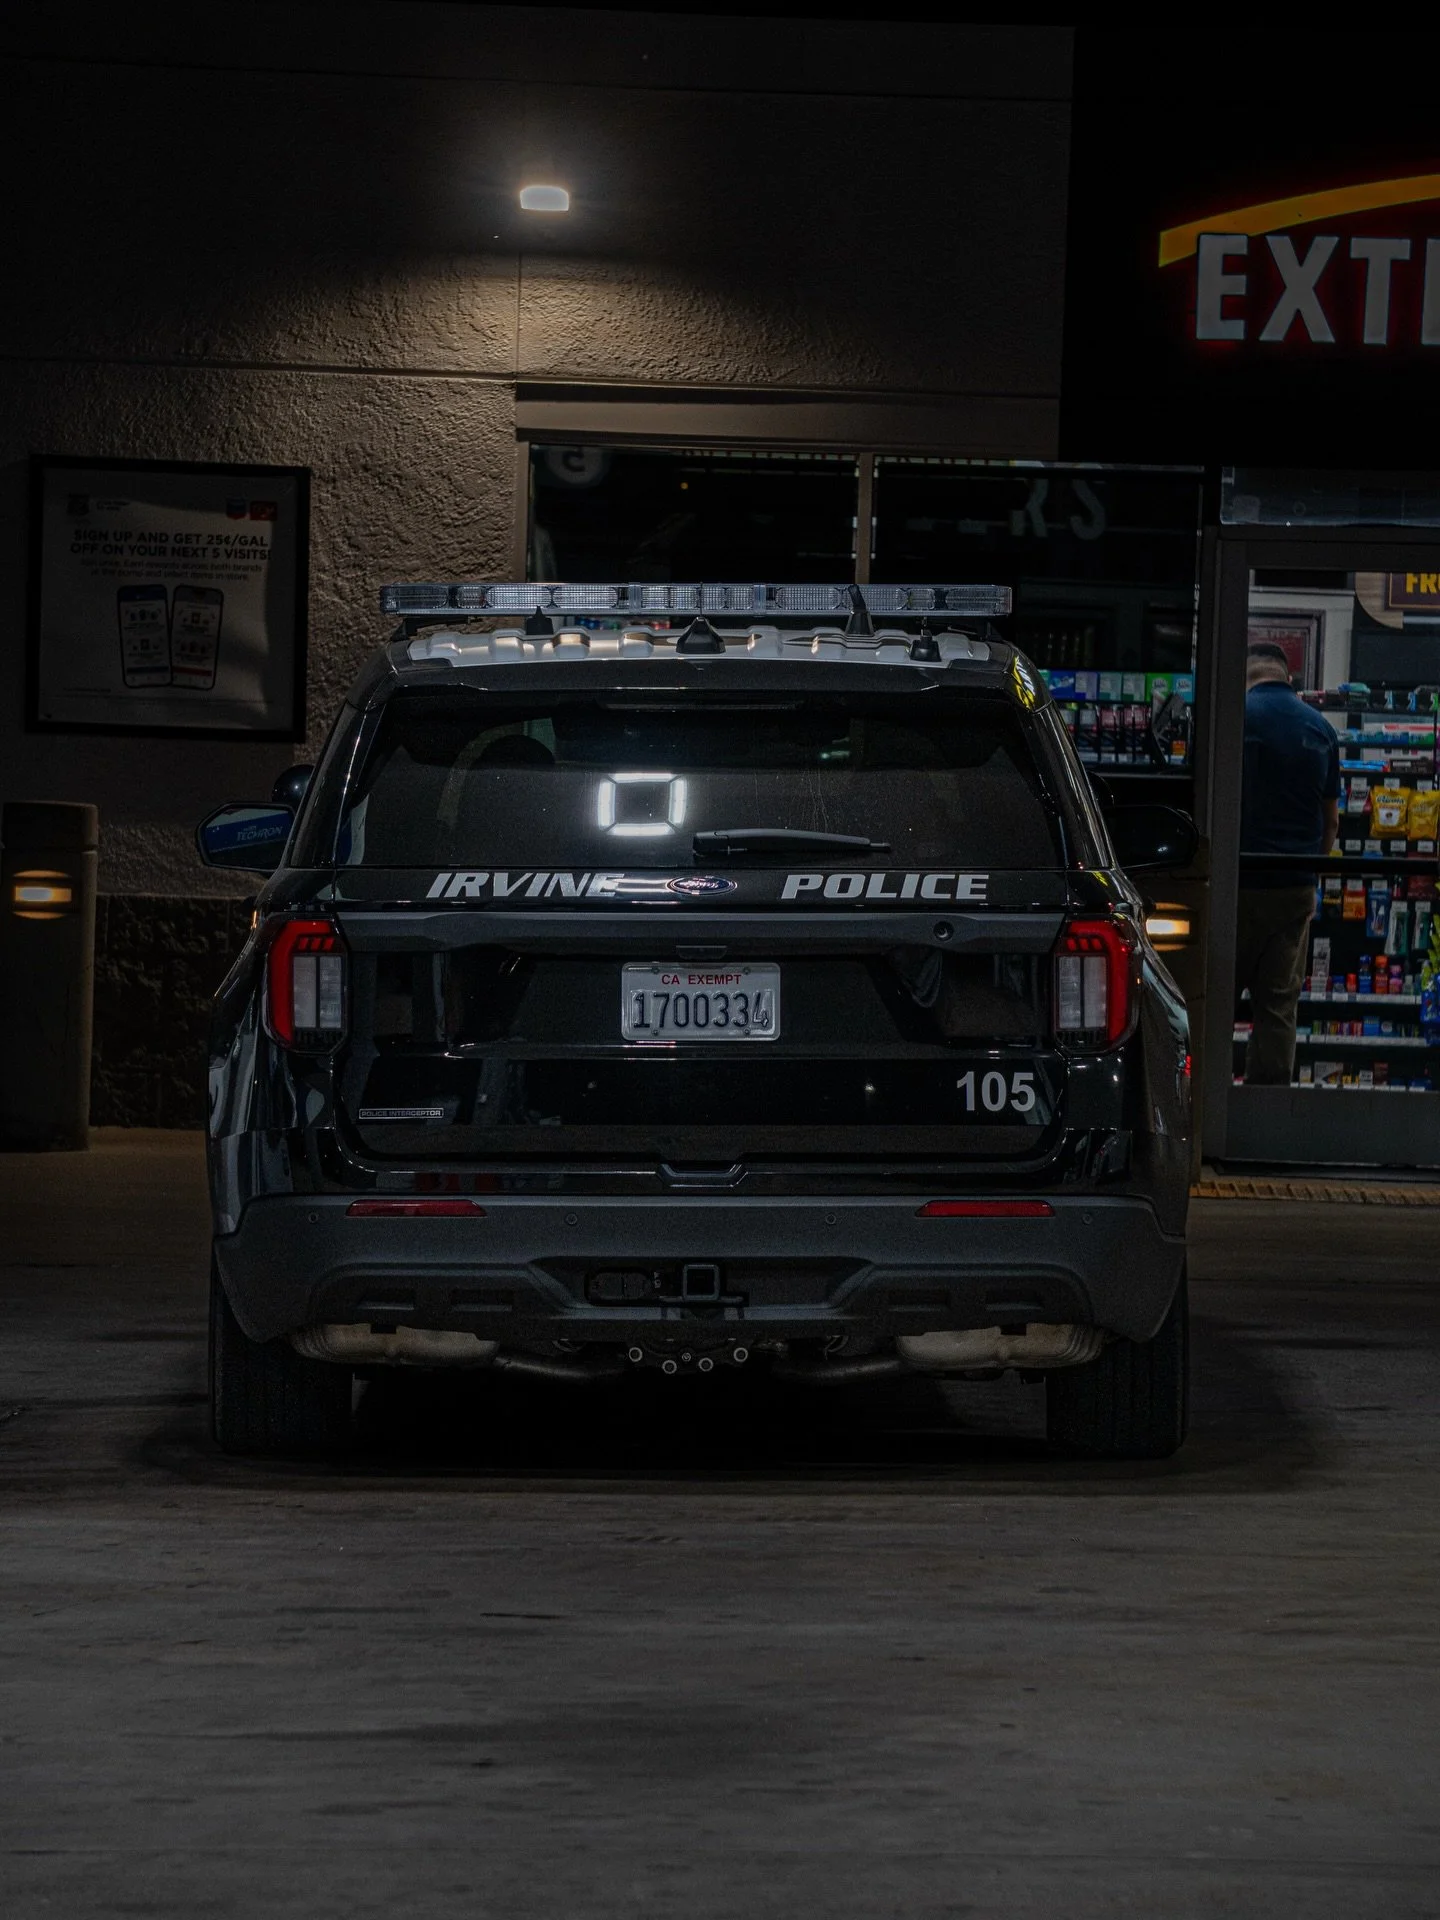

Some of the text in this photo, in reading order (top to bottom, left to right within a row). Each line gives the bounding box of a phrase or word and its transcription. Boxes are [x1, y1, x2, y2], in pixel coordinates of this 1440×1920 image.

[74, 529, 269, 547] SIGN UP AND GET 25¢/GAL
[70, 542, 272, 560] OFF ON YOUR NEXT 5 VISITS!
[1406, 573, 1440, 593] FR
[426, 872, 625, 899] IRVINE
[781, 873, 989, 900] POLICE
[661, 974, 742, 985] CA EXEMPT
[633, 991, 769, 1028] 1700334
[956, 1070, 1036, 1112] 105
